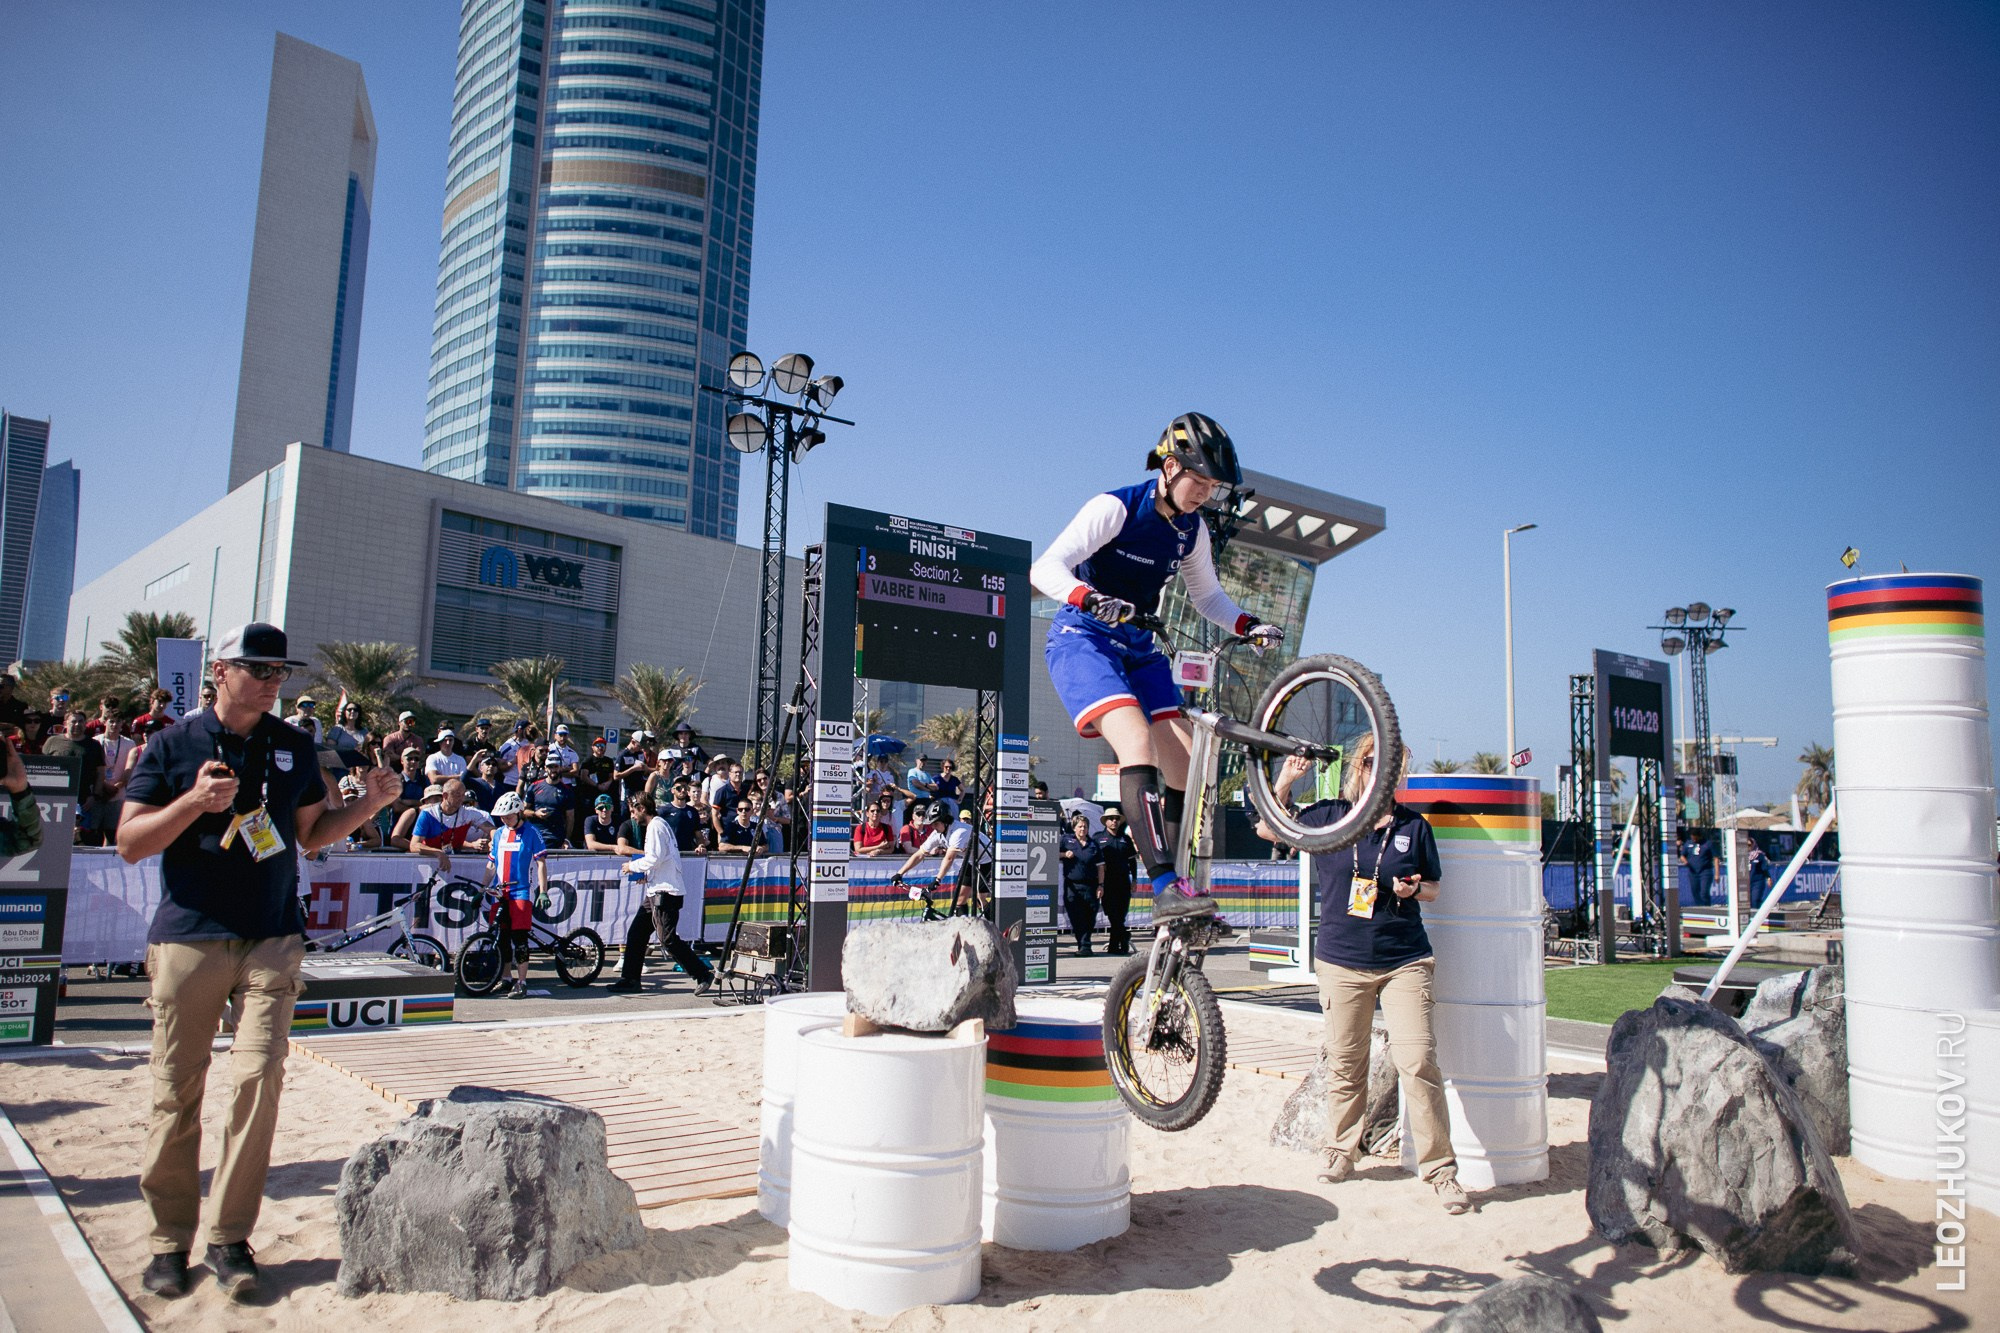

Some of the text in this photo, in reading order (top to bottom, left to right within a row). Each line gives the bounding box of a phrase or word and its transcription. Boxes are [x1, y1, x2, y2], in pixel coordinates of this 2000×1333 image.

[892, 518, 907, 528] UCI
[910, 539, 956, 560] FINISH
[524, 553, 584, 590] VOX
[868, 555, 876, 570] 3
[909, 562, 963, 583] -Section 2-
[872, 578, 946, 604] VABRE Nina
[981, 574, 1006, 592] 1:55
[1614, 706, 1659, 733] 11:20:28
[608, 730, 616, 742] P
[826, 724, 850, 736] UCI
[0, 802, 68, 822] TRT
[822, 866, 846, 878] UCI
[1006, 865, 1024, 876] UCI
[1030, 846, 1048, 881] 2
[360, 880, 620, 930] TISOT
[331, 999, 397, 1028] UCI
